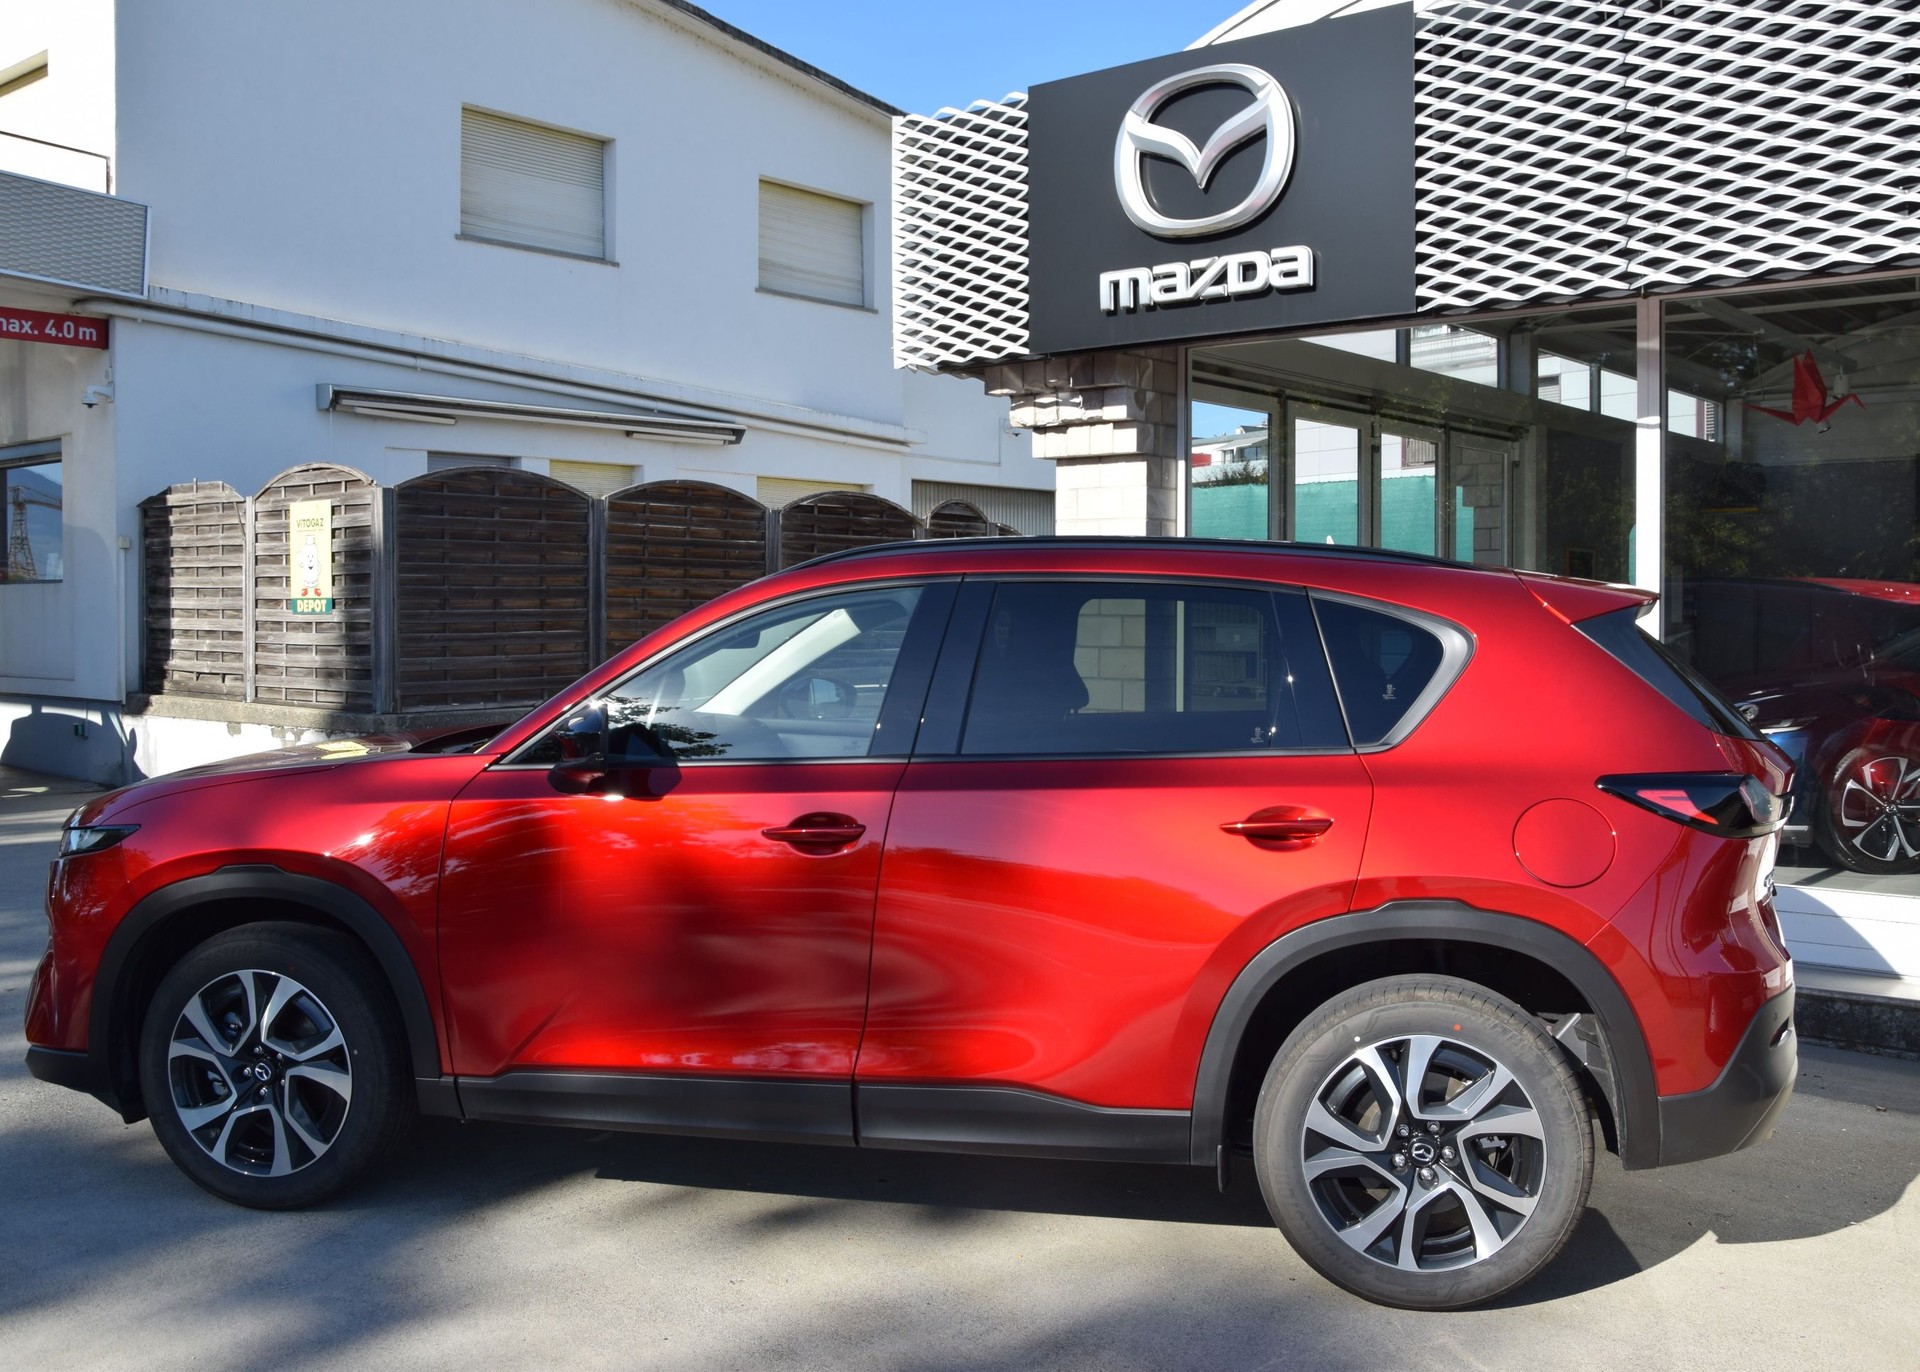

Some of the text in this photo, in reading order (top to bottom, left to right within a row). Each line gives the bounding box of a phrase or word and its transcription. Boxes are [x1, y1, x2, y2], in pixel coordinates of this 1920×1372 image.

[1099, 245, 1314, 312] mazda
[44, 319, 75, 339] 4.0
[79, 326, 97, 341] m
[297, 599, 327, 613] DEPOT
